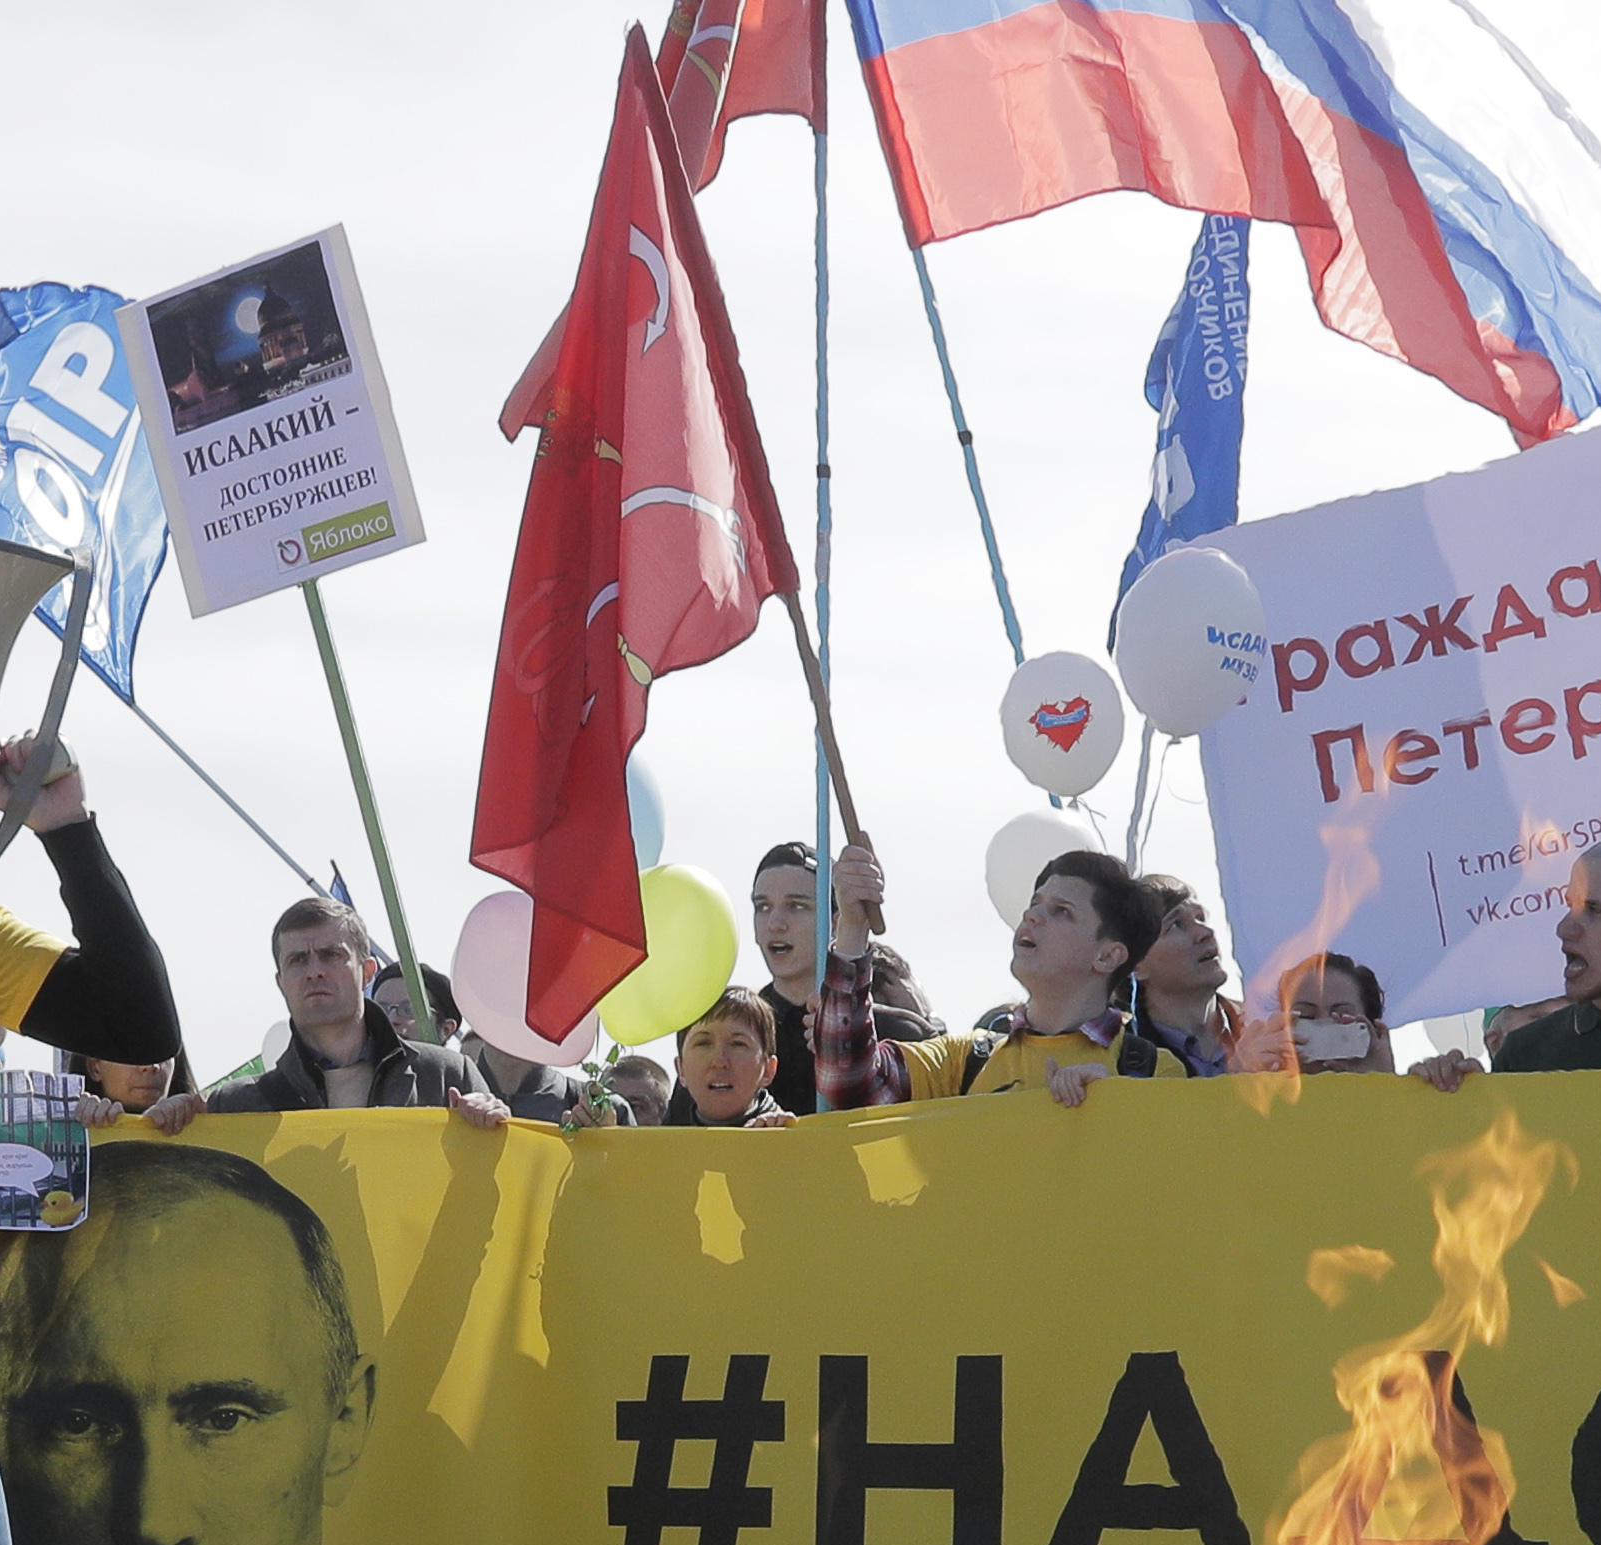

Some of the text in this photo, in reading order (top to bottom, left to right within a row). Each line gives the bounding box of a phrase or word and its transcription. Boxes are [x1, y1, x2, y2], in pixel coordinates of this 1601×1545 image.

[183, 395, 337, 477] ИСААКИЙ
[203, 467, 378, 542] ПЕТЕРБУРЖЦЕВ!
[220, 447, 347, 510] ДОСТОЯНИЕ
[309, 515, 389, 554] Яблоко
